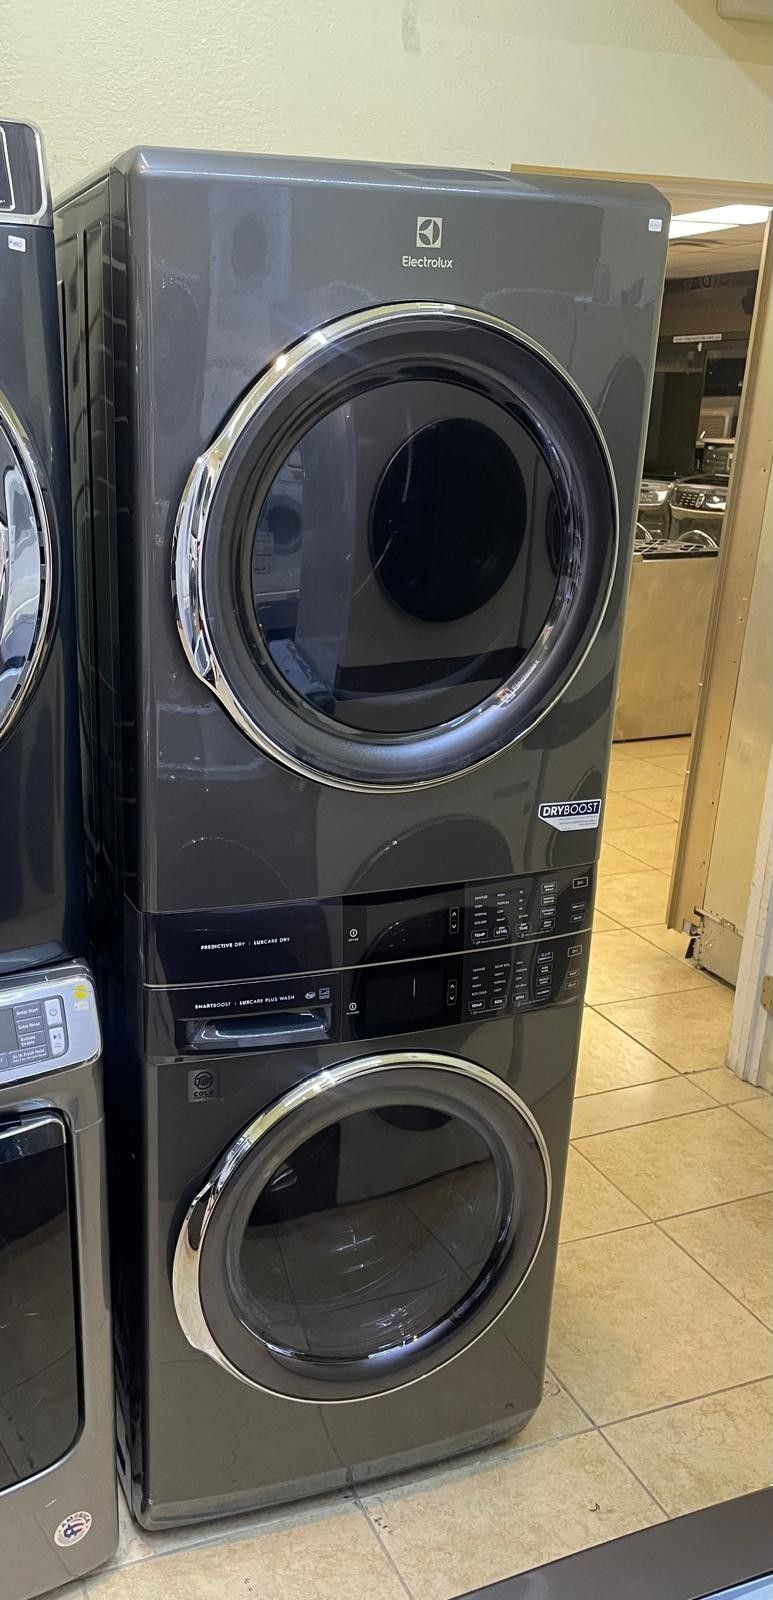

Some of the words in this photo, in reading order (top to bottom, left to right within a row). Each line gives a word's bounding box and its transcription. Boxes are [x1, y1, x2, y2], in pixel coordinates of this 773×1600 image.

[402, 255, 453, 268] Electrolux
[542, 802, 598, 817] DRYBOOST
[200, 942, 233, 950] PREDICTIVE
[253, 938, 278, 946] LUXCARE
[194, 1001, 231, 1010] SMARTBOOST
[239, 998, 264, 1006] LUXCARE
